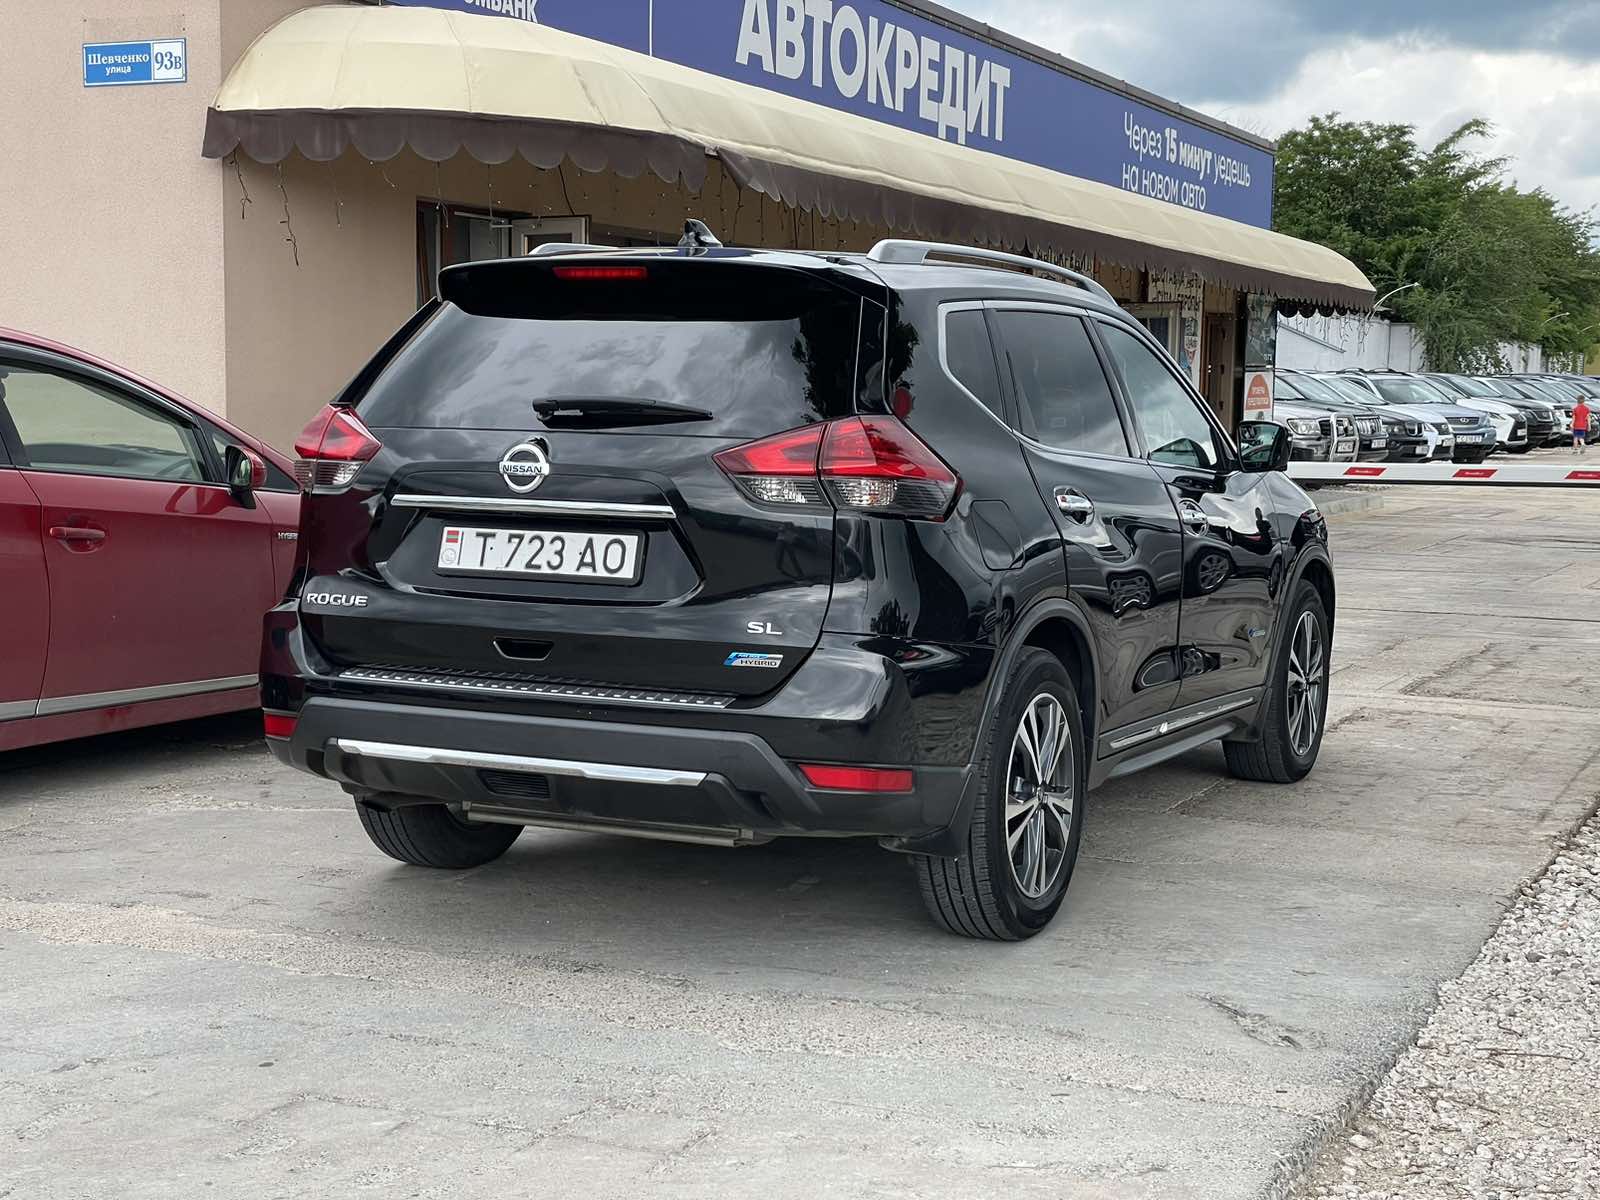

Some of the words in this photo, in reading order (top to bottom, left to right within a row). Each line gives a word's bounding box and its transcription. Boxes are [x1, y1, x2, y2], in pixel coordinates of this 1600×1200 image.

[464, 0, 538, 23] АНК
[87, 53, 150, 65] Шевченко
[105, 65, 132, 76] улица
[735, 0, 1011, 145] АВТОКРЕДИТ
[1124, 111, 1162, 162] Через
[1165, 127, 1177, 163] 15
[1179, 141, 1213, 180] минут
[1214, 153, 1251, 187] уедешь
[1122, 162, 1139, 193] на
[1142, 169, 1179, 203] новом
[1181, 181, 1207, 210] авто
[502, 464, 542, 473] NISSAN
[475, 531, 496, 567] T
[505, 533, 566, 571] 723
[576, 537, 627, 575] AO
[306, 593, 369, 607] ROGUE
[746, 621, 783, 635] SL
[740, 659, 778, 667] HYBRID
